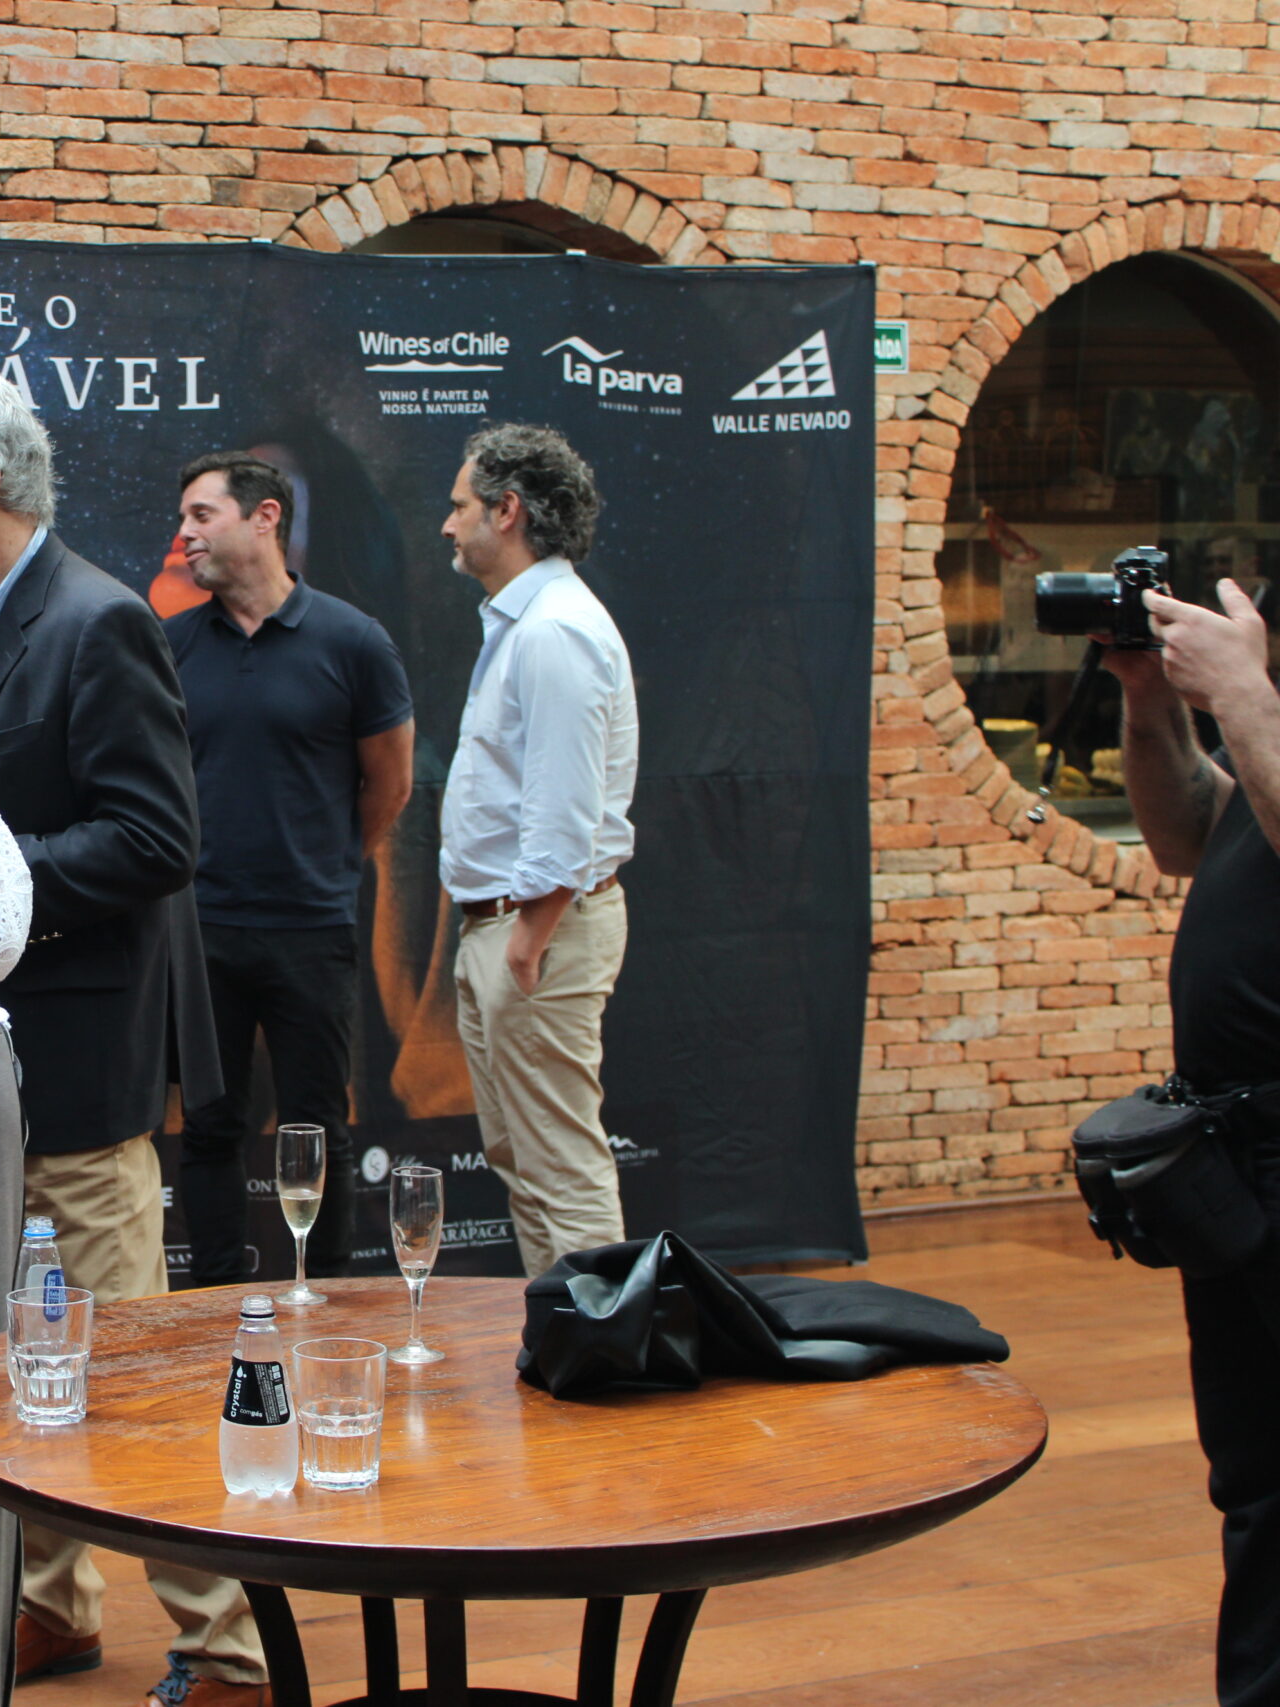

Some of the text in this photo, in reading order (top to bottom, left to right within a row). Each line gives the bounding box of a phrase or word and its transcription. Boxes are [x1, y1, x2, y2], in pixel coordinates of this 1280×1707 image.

[44, 295, 77, 329] O
[358, 330, 510, 356] Wines of Chile
[873, 334, 903, 360] AÍDA
[563, 352, 683, 397] la parva
[378, 387, 490, 402] VINHO É PARTE DA
[381, 402, 487, 415] NOSSA NATUREZA
[712, 410, 852, 434] VALLE NEVADO
[230, 1378, 242, 1418] crystal
